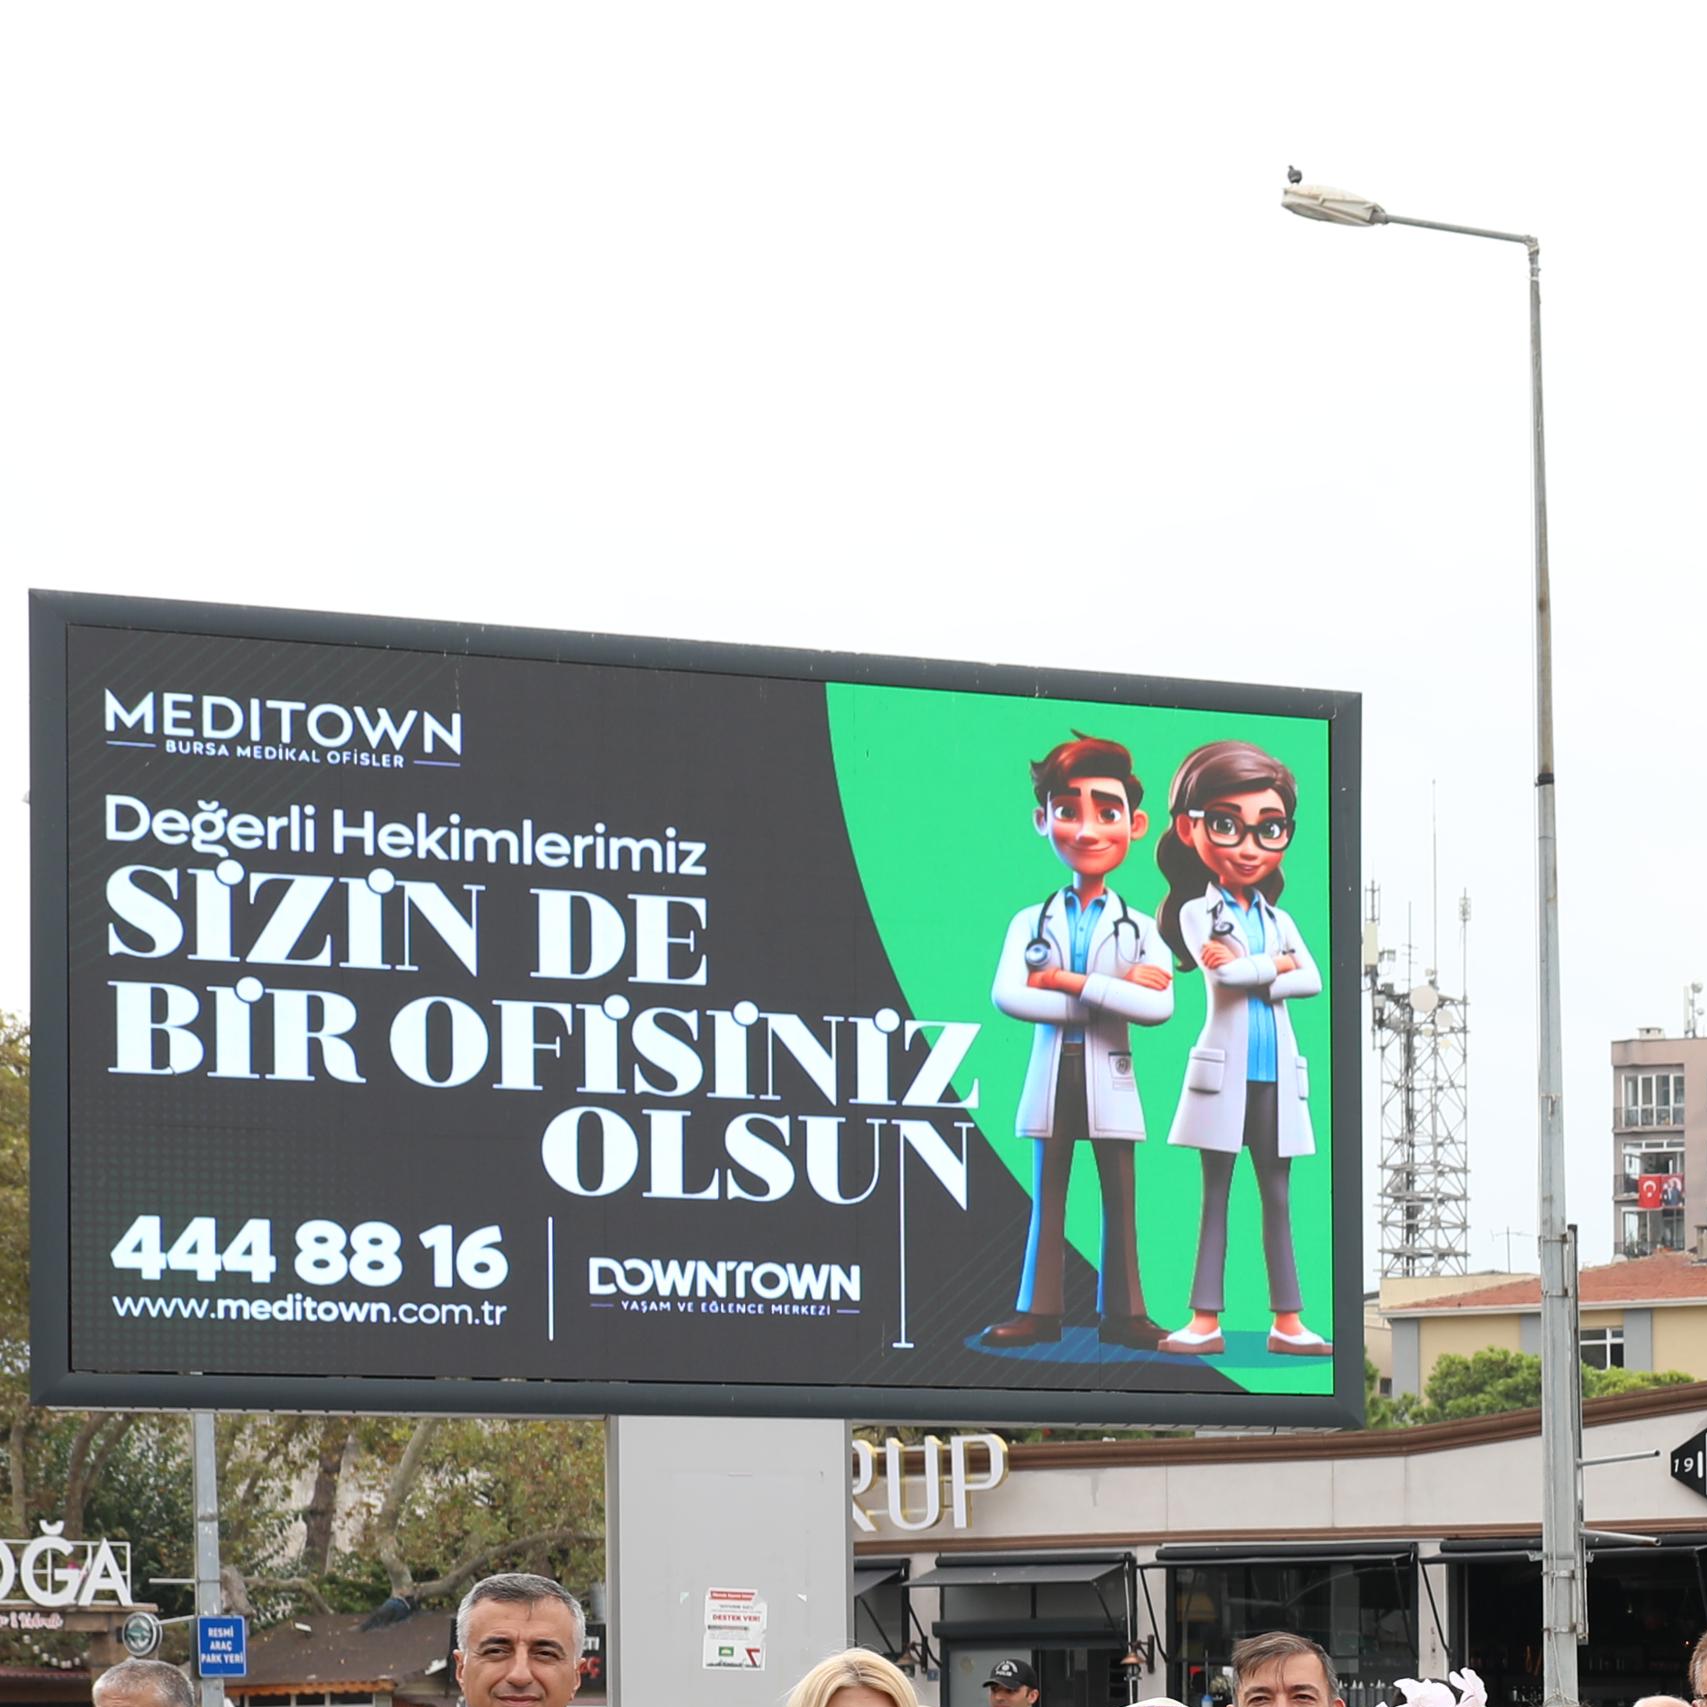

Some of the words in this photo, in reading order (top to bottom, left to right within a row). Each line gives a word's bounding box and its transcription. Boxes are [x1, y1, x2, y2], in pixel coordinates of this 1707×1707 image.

[105, 688, 461, 755] MEDITOWN
[166, 739, 229, 757] BURSA
[236, 744, 320, 764] MEDİKAL
[327, 748, 404, 768] OFİSLER
[105, 794, 316, 857] Değerli
[333, 808, 707, 876] Hekimlerimiz
[105, 859, 485, 977] SİZİN
[530, 889, 708, 985] DE
[107, 976, 366, 1084] BİR
[389, 993, 981, 1108] OFİSİNİZ
[541, 1106, 975, 1210] OLSUN
[111, 1215, 276, 1283] 444
[293, 1219, 403, 1288] 88
[420, 1224, 509, 1290] 16
[589, 1257, 861, 1301] DOWNTOWN
[111, 1292, 507, 1327] www.meditown.com.tr
[621, 1300, 671, 1313] YAŞAM
[677, 1301, 694, 1312] VE
[701, 1300, 764, 1314] EĞLENCE
[1674, 1457, 1694, 1473] 19
[208, 1625, 234, 1638] RESMİ
[210, 1640, 232, 1652] ARAÇ
[201, 1653, 222, 1664] PARK
[223, 1651, 244, 1664] YERİ
